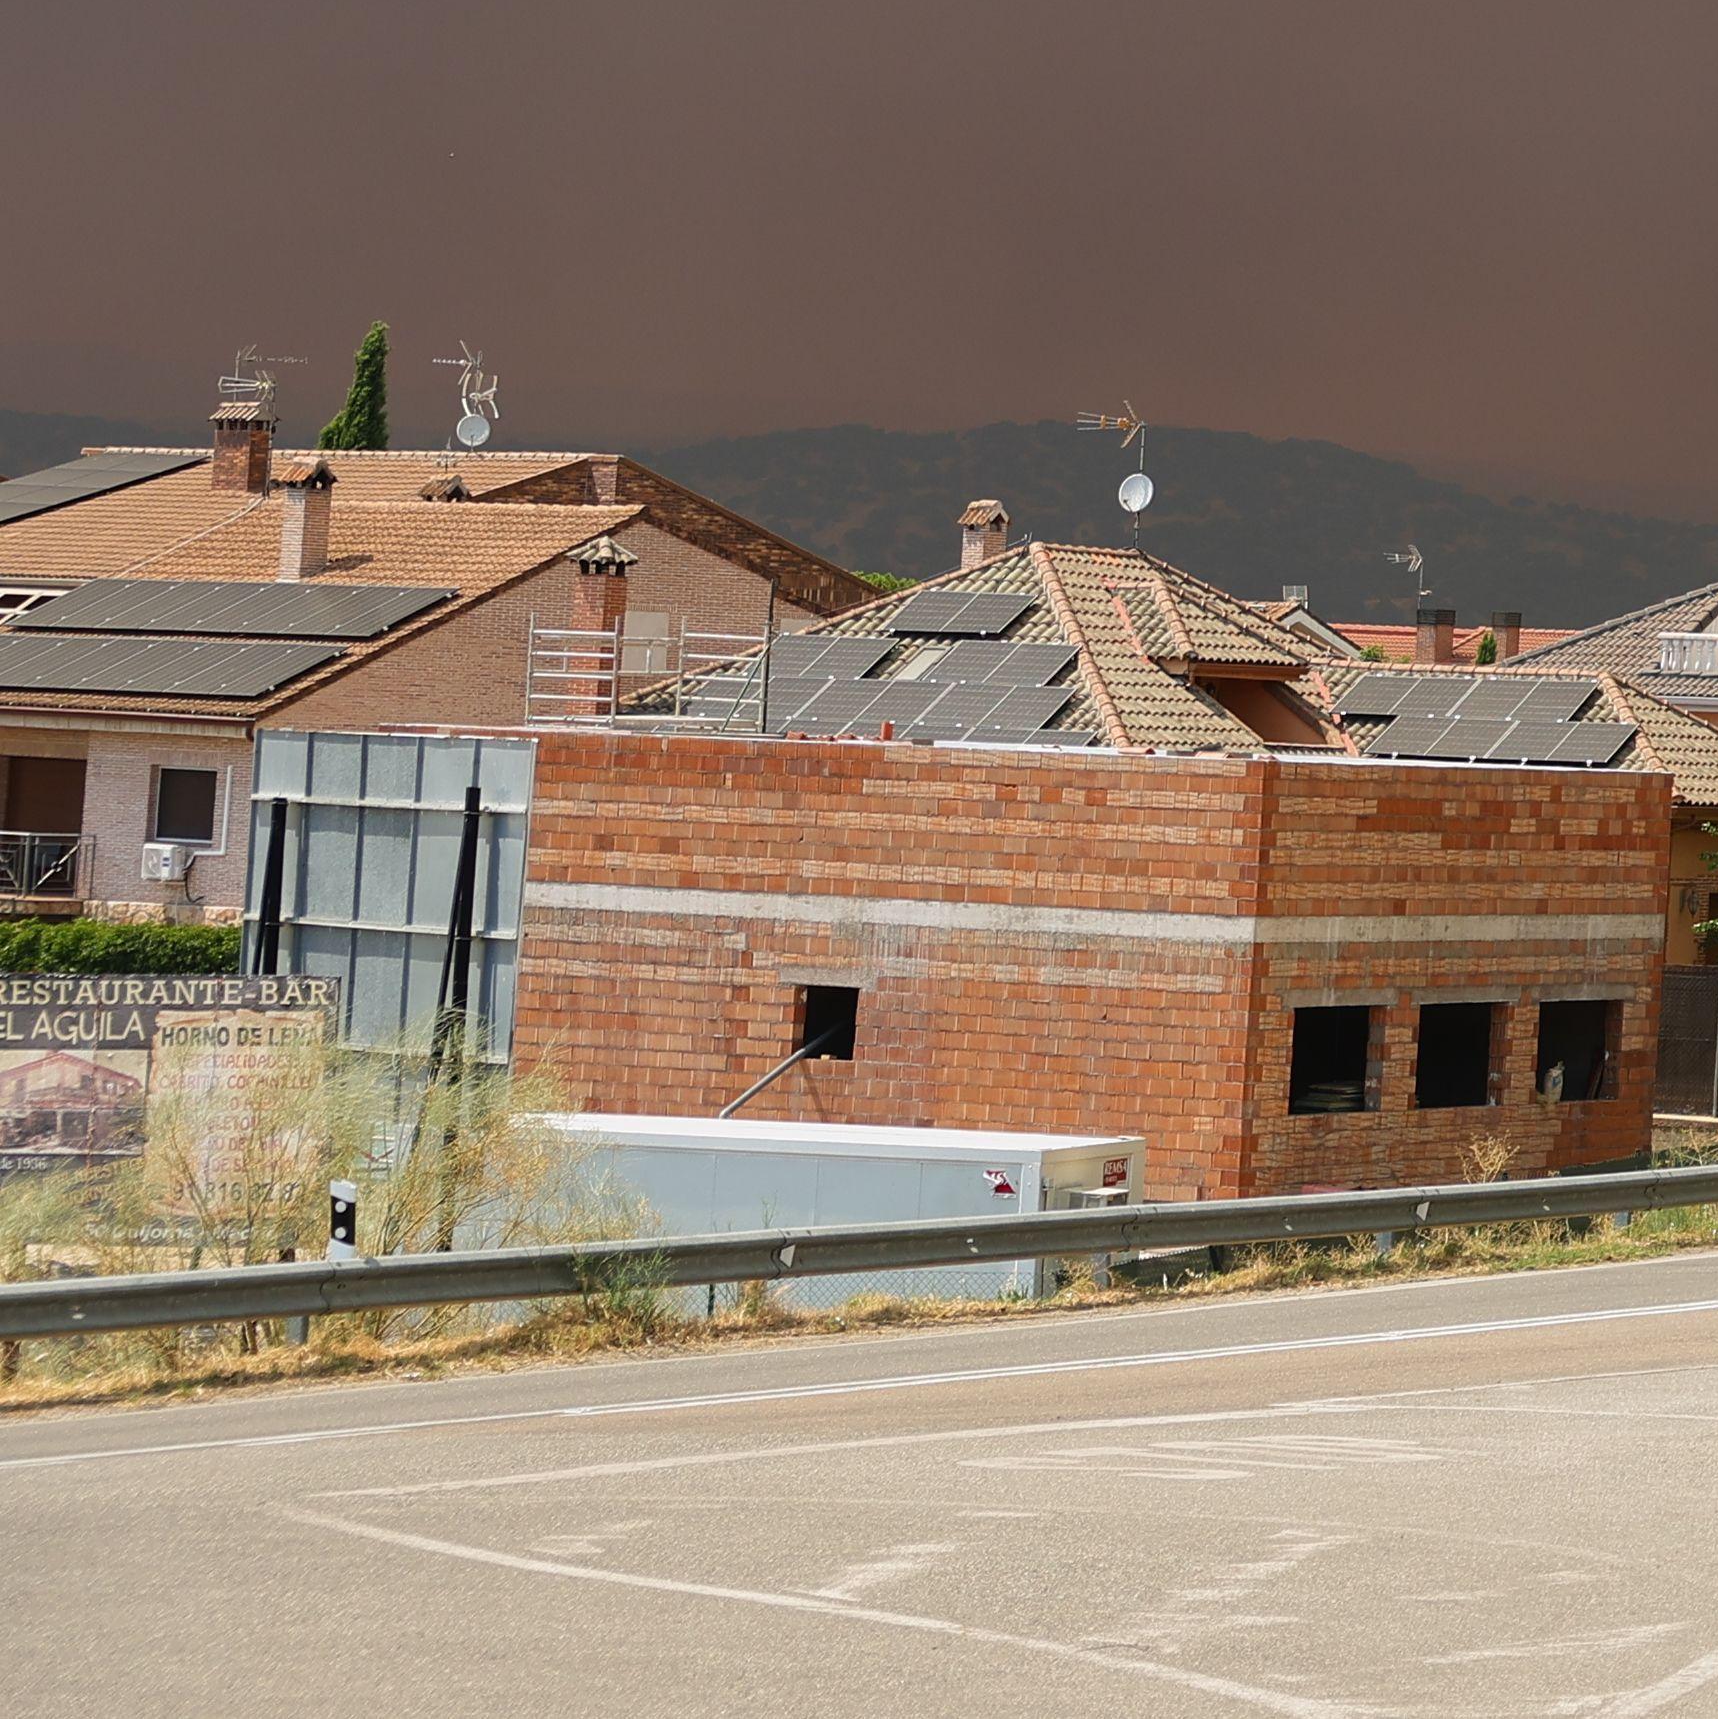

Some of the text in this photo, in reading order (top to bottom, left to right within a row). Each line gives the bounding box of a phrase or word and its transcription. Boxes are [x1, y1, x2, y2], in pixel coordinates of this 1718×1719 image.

[30, 1009, 145, 1045] AGUILA
[161, 1026, 230, 1047] HORNO
[236, 1026, 262, 1047] DE
[1104, 1160, 1128, 1175] REMSA
